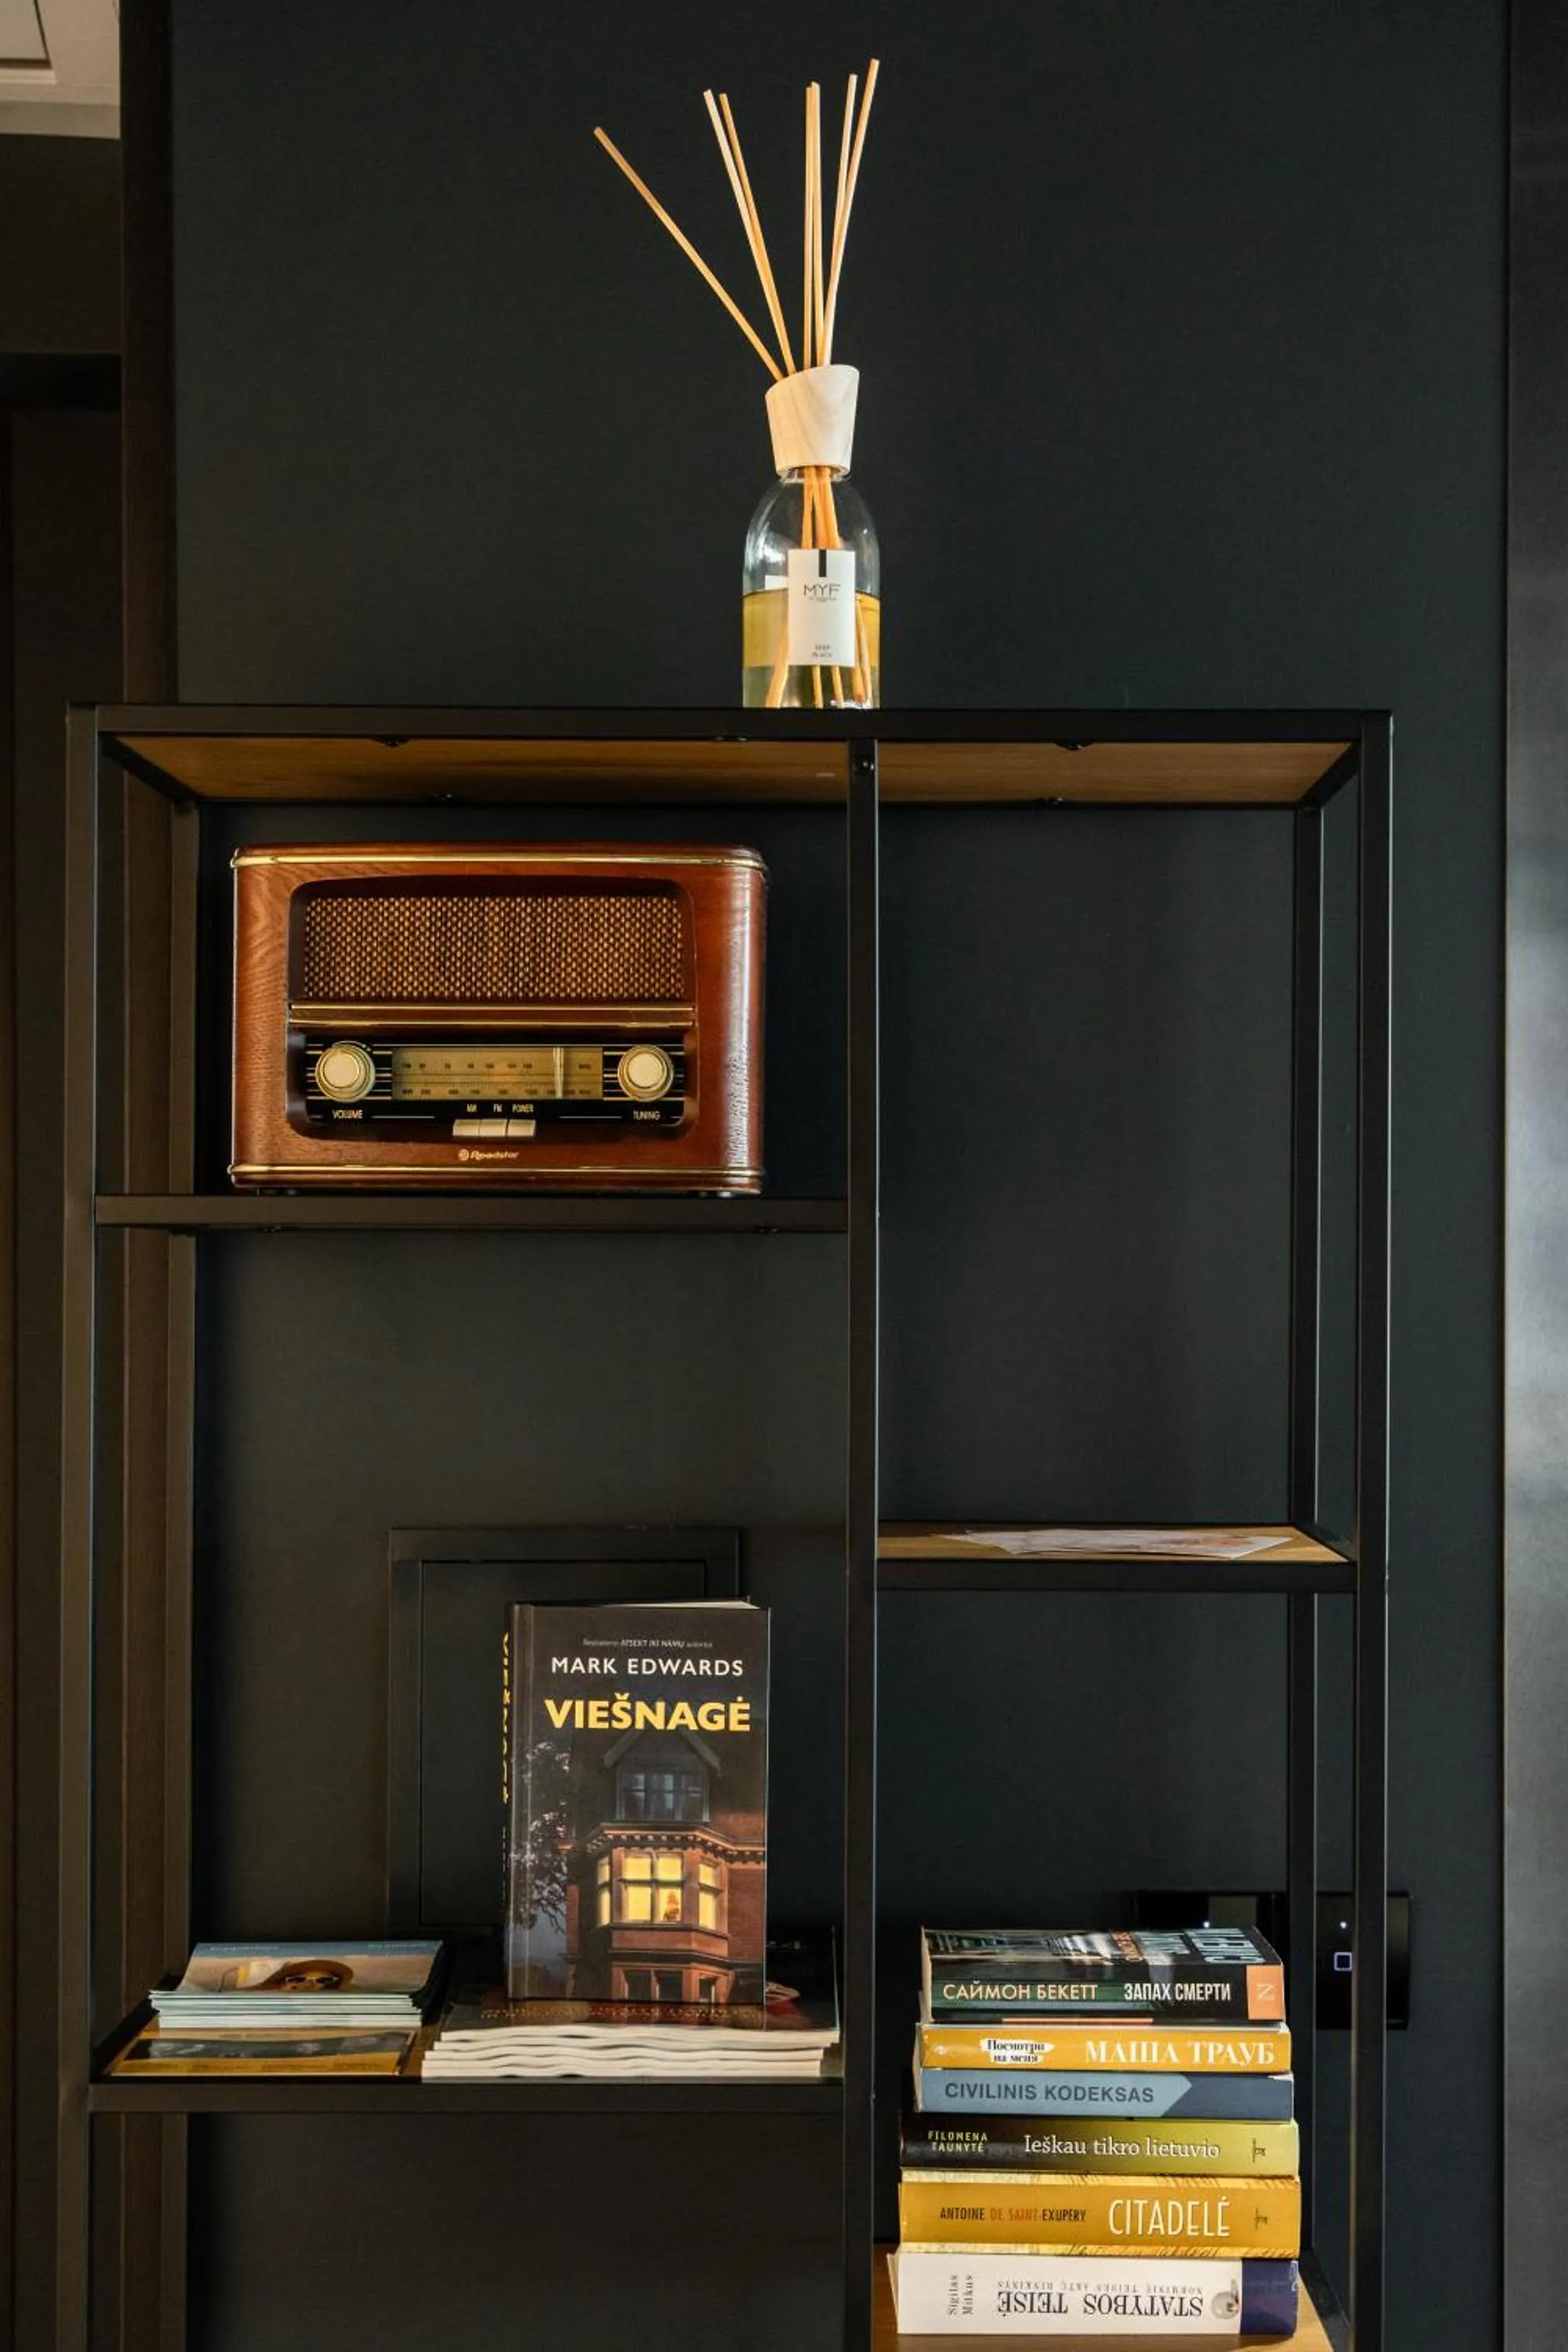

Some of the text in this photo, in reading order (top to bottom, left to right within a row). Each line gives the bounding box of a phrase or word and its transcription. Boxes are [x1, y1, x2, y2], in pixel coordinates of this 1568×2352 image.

[804, 583, 841, 596] MYF
[332, 1109, 363, 1120] VOLUME
[633, 1110, 660, 1120] TUNING
[551, 1657, 743, 1676] MARK EDWARDS
[544, 1693, 751, 1731] VIEŠNAGĖ
[943, 1980, 1098, 2000] САЙМОН БЕКЕТТ
[1123, 1983, 1231, 2002] ЗАПАХ СМЕРТИ
[987, 2039, 1045, 2054] Посмотри
[1086, 2040, 1276, 2067] МАША ТРАУБ
[944, 2082, 1154, 2103] CIVILINIS KODEKSAS
[927, 2130, 988, 2141] FILOMENA
[1024, 2135, 1220, 2158] Ieškau tikro lietuvio
[941, 2207, 985, 2221] ANTOINE
[990, 2208, 1004, 2221] DE
[1109, 2195, 1230, 2237] CITADELĖ
[997, 2290, 1203, 2318] STATYBOS TEISĖ
